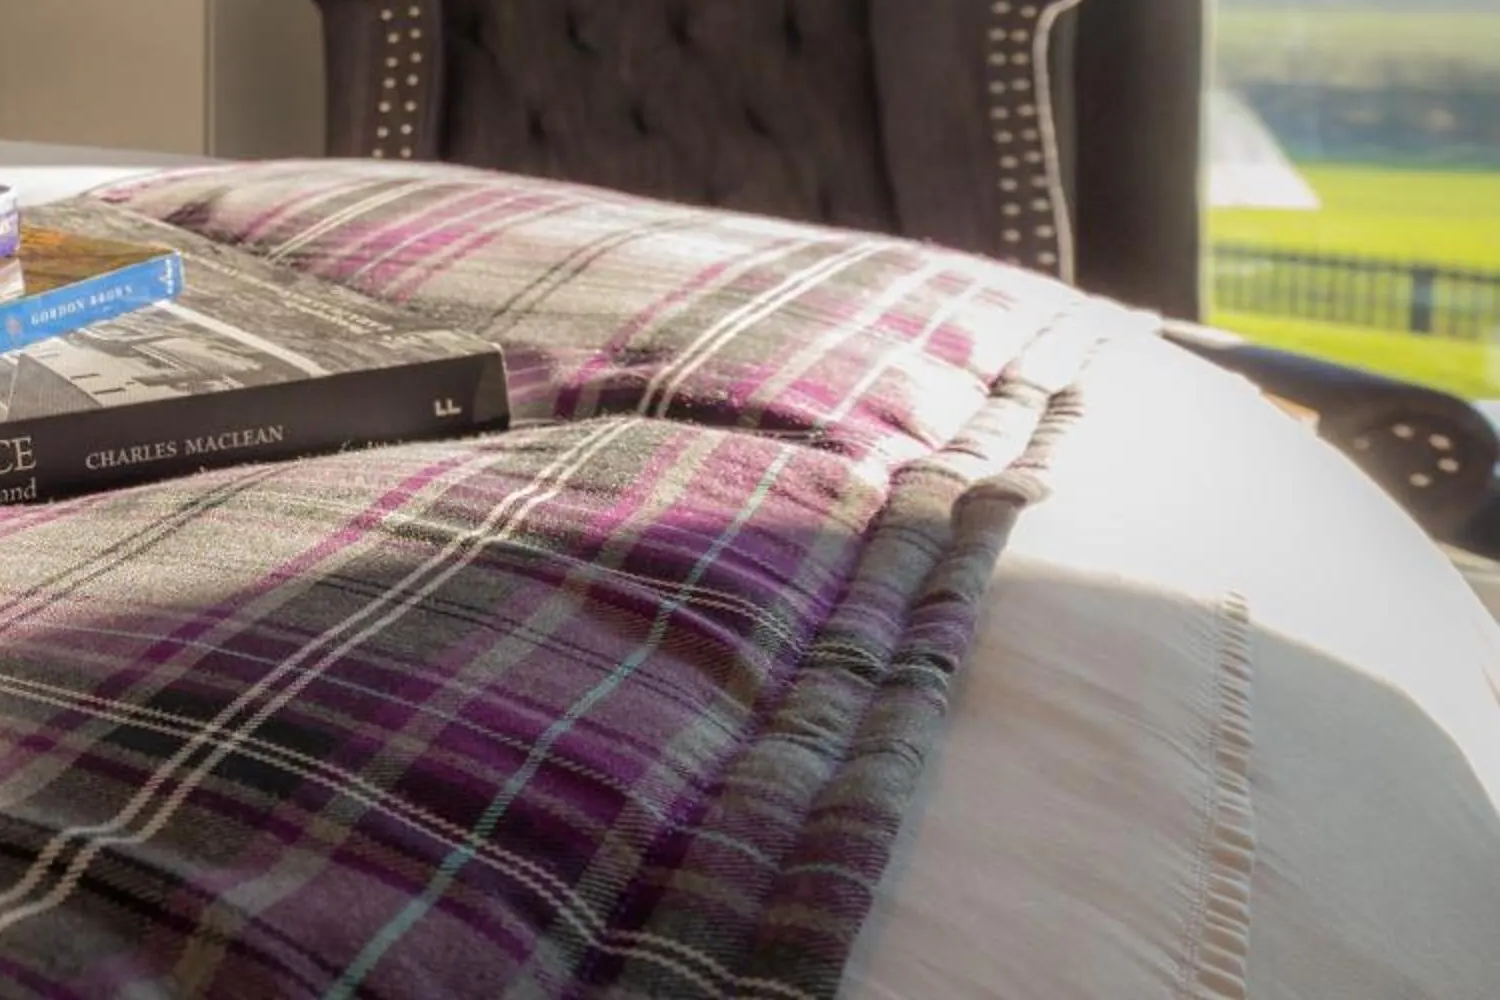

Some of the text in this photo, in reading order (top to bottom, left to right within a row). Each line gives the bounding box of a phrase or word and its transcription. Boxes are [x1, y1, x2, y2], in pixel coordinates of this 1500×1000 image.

[31, 299, 85, 325] GORDON
[86, 425, 283, 469] CHARLES MACLEAN
